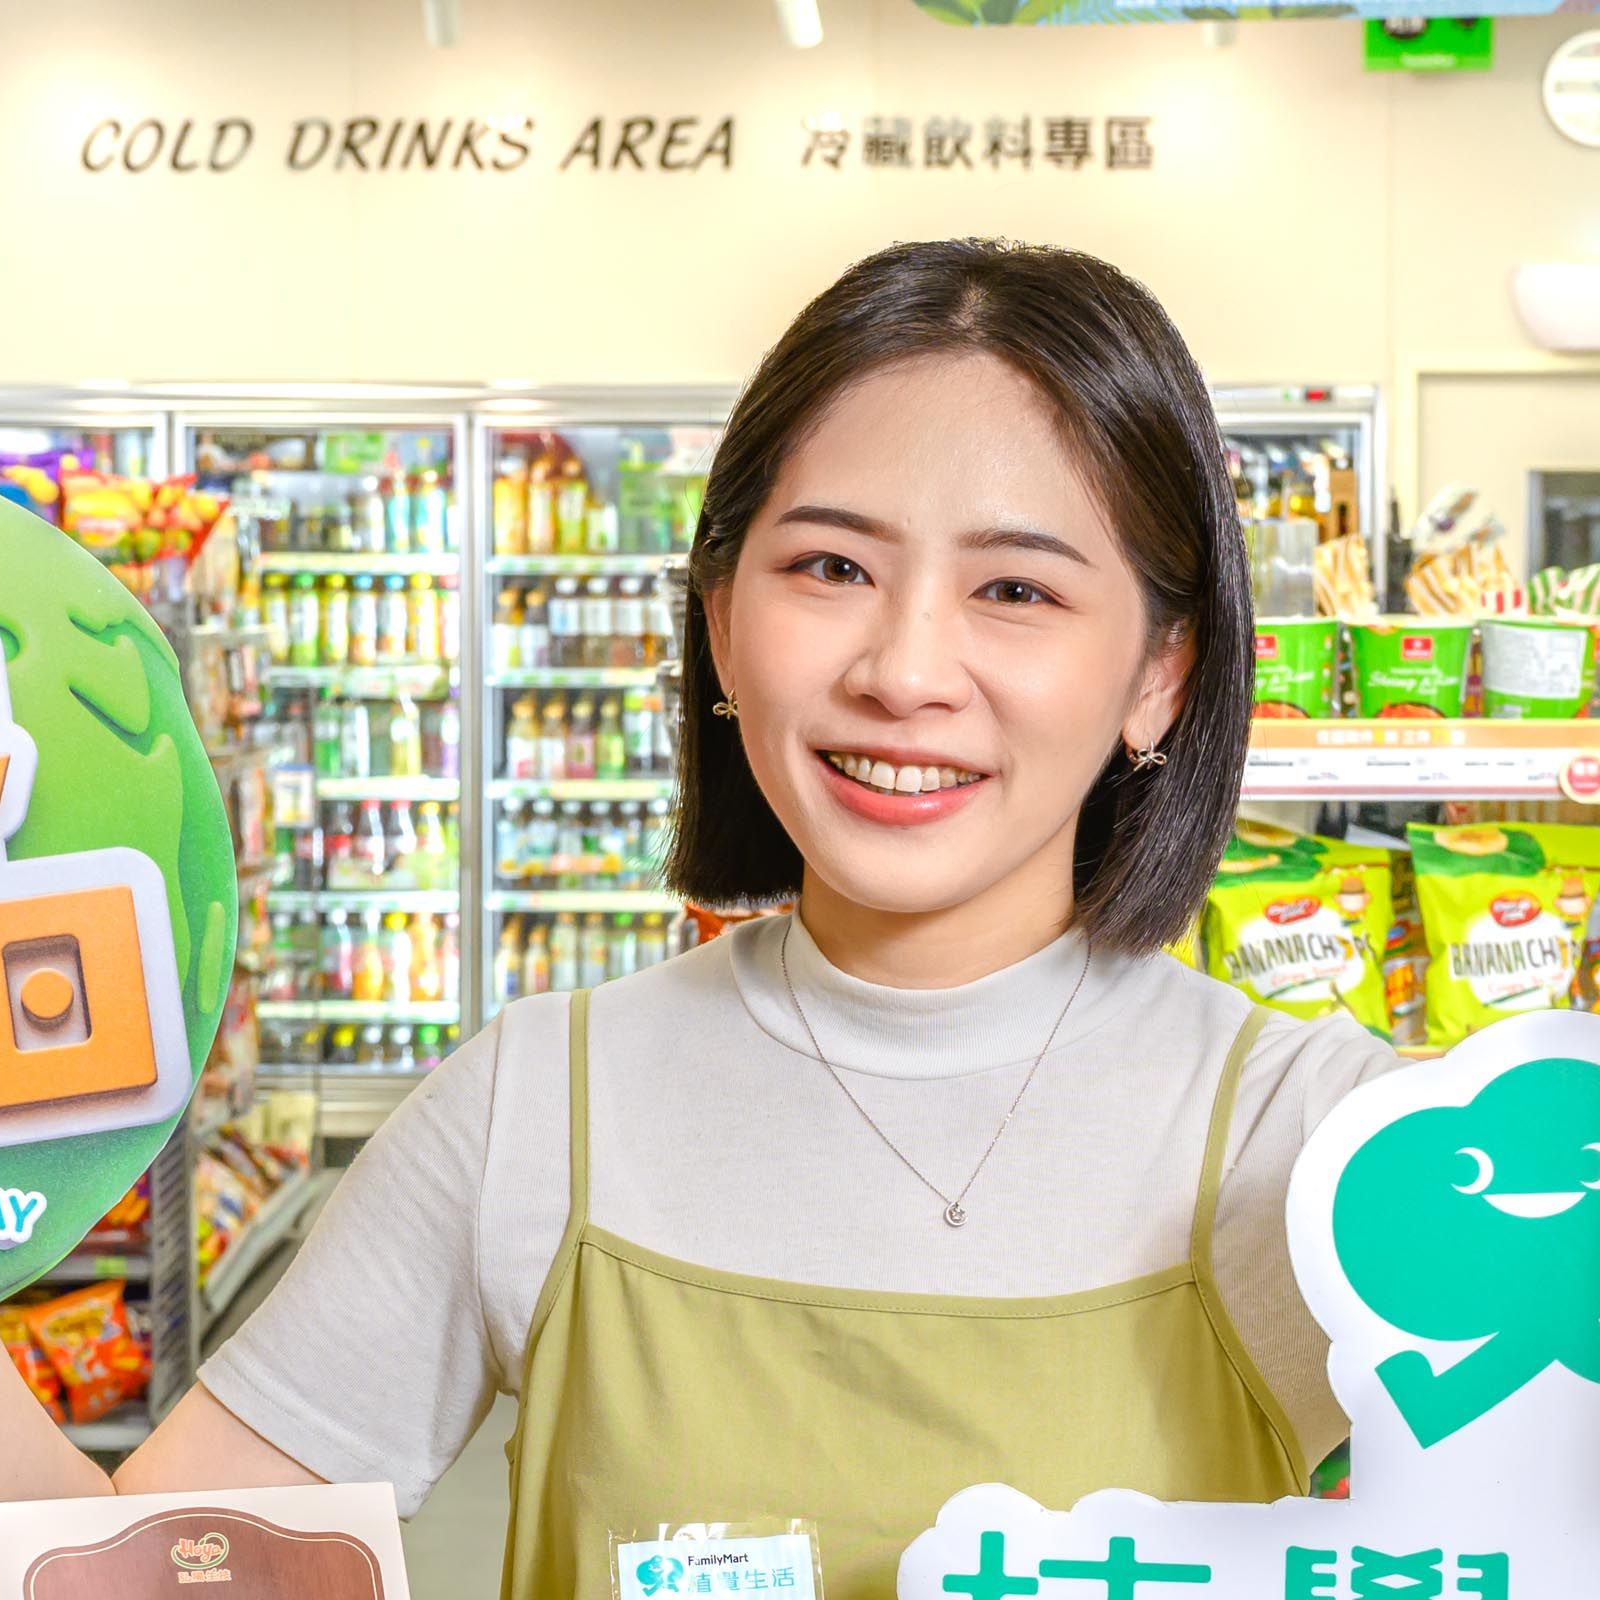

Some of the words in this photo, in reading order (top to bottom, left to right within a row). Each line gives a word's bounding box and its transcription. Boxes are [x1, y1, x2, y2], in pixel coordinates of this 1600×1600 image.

[80, 116, 255, 174] COLD
[285, 116, 534, 174] DRINKS
[560, 114, 736, 173] AREA
[687, 1553, 750, 1567] FamilyMart
